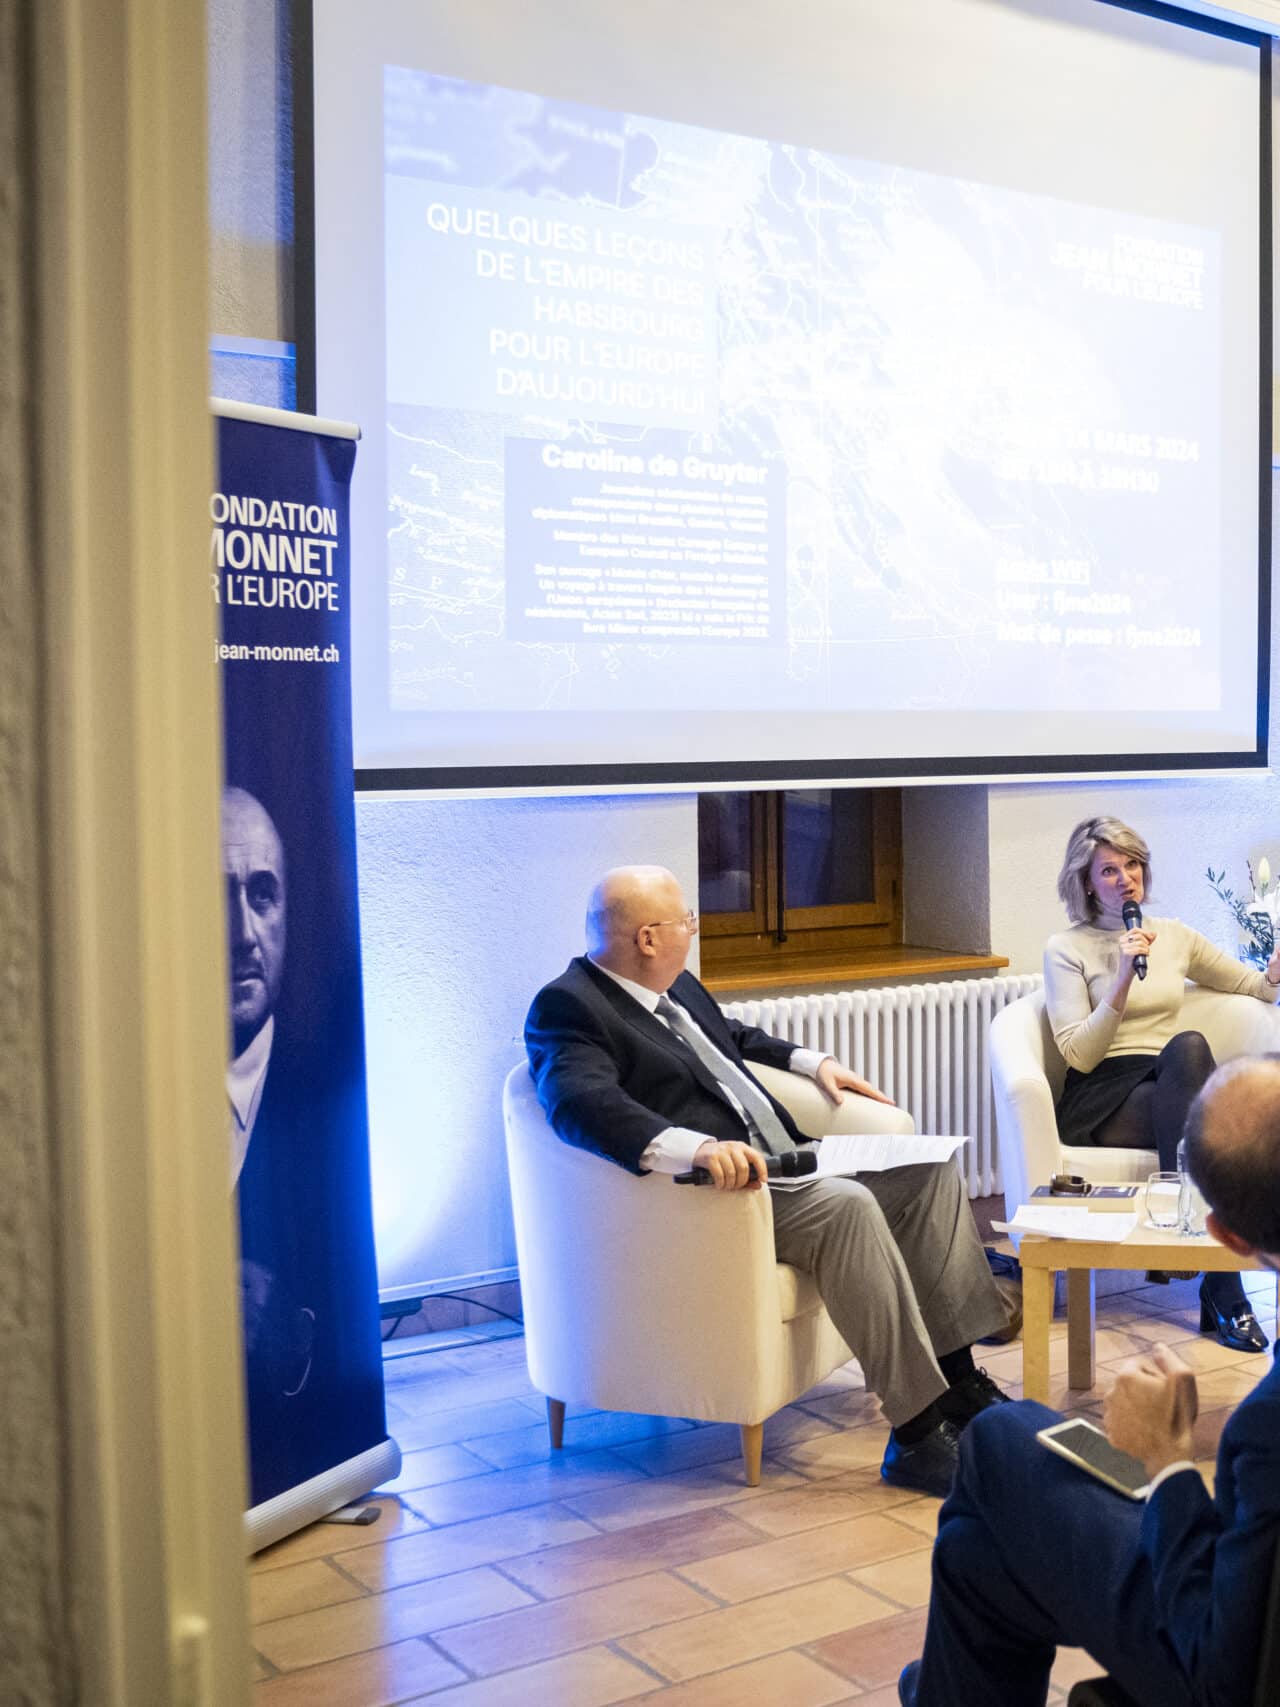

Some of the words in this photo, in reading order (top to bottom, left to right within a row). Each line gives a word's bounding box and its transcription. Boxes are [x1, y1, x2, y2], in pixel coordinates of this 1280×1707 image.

[427, 203, 586, 250] QUELQUES
[595, 227, 704, 272] LEÇONS
[475, 249, 516, 280] DE
[524, 256, 646, 299] L'EMPIRE
[489, 328, 572, 365] POUR
[541, 443, 645, 474] Caroline
[648, 453, 679, 477] de
[682, 456, 769, 486] Gruyter
[210, 492, 338, 536] ONDATION
[227, 574, 340, 612] L'EUROPE
